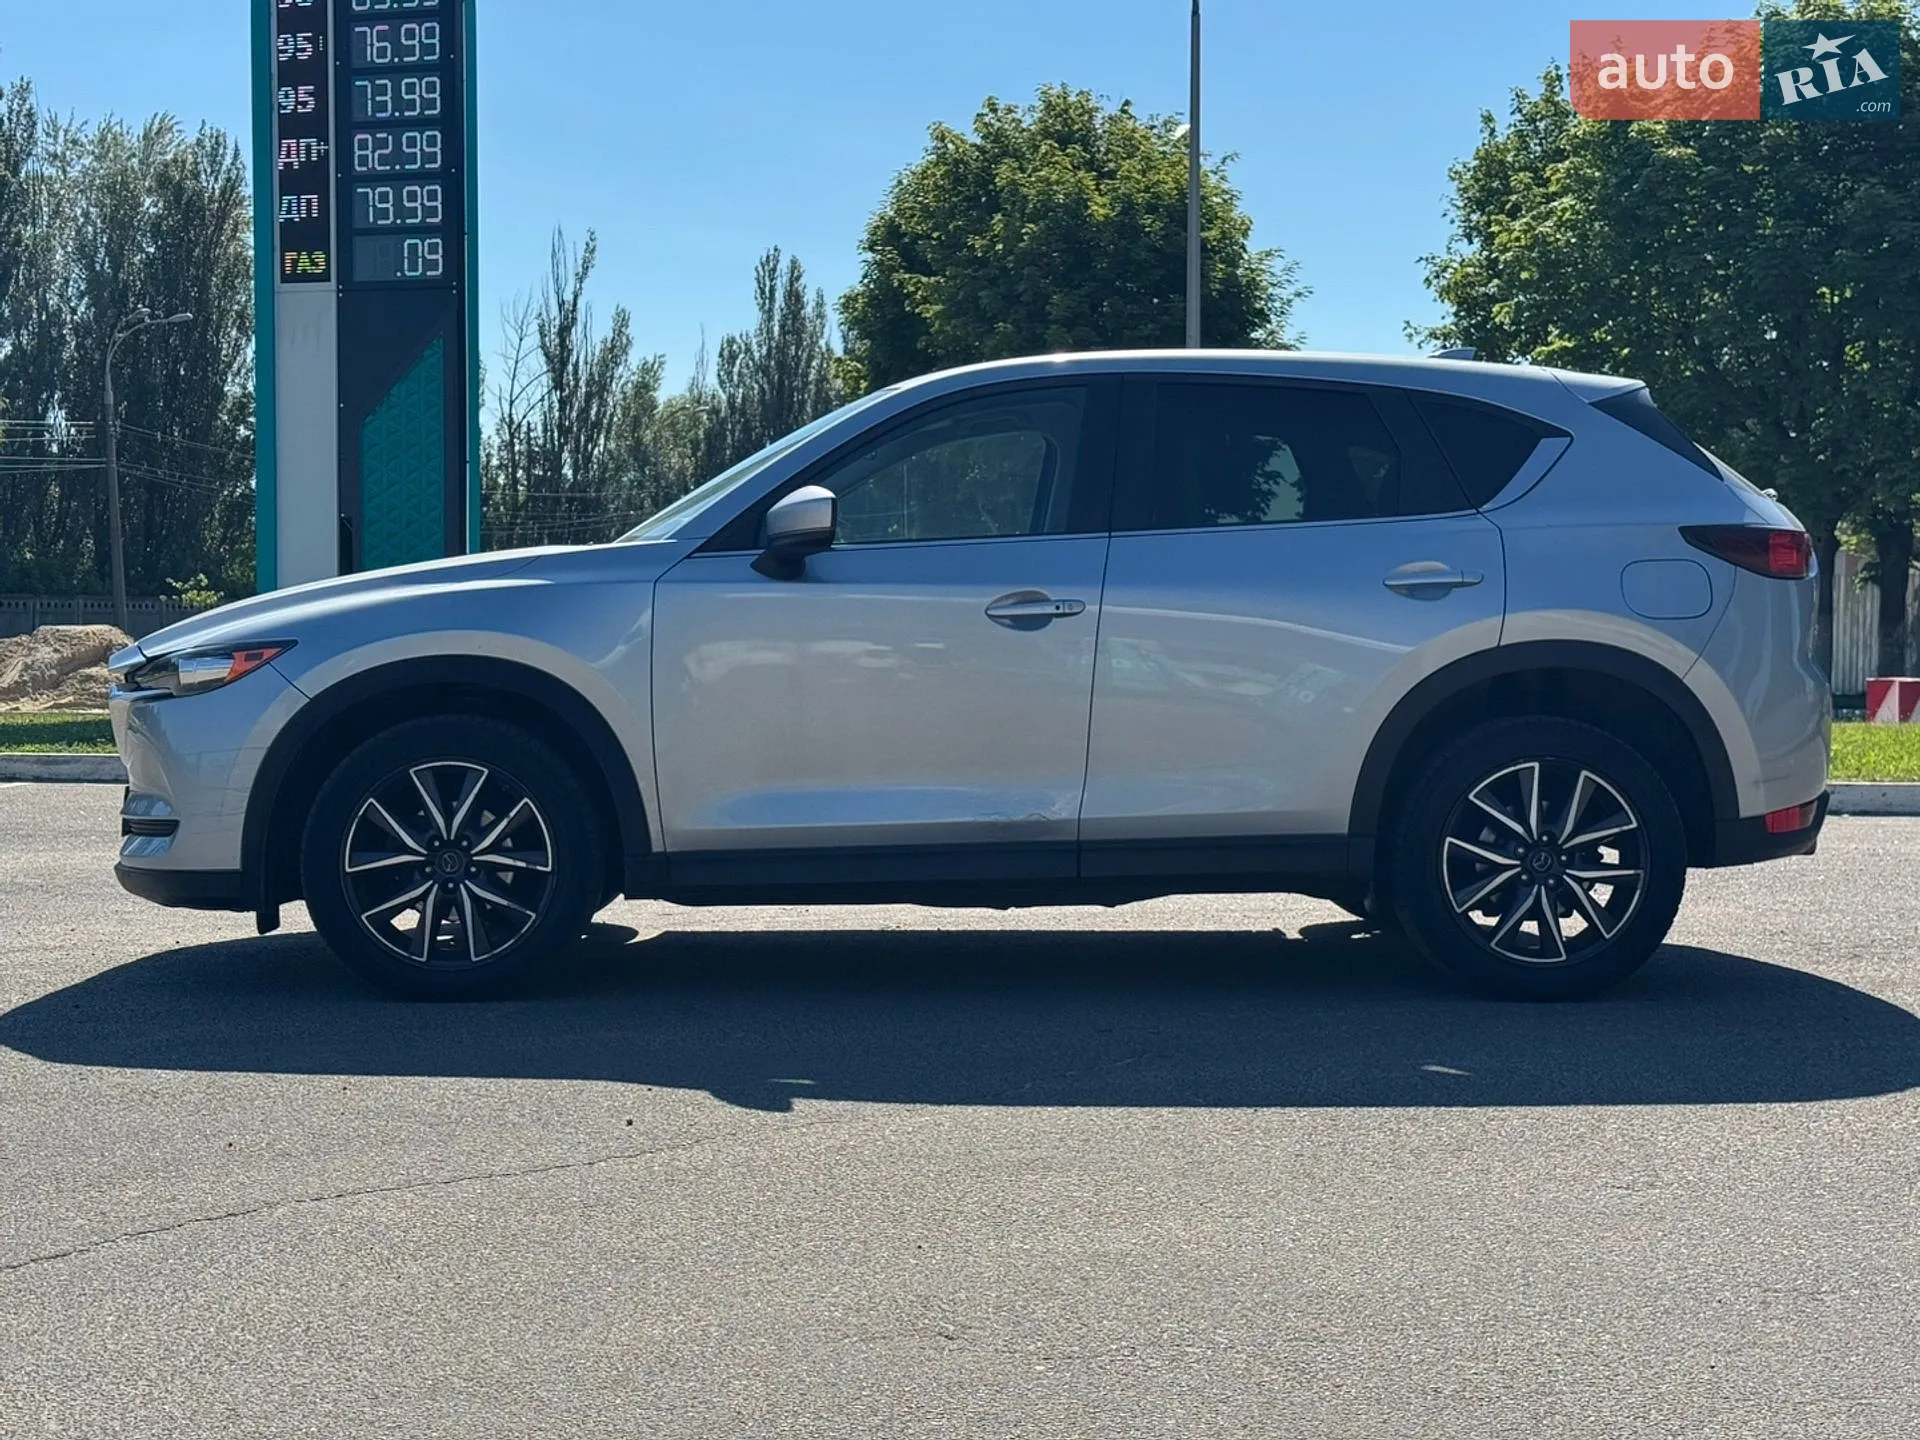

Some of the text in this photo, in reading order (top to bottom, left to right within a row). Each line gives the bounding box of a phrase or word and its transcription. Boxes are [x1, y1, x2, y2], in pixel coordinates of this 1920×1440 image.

[354, 22, 440, 64] 76.99
[277, 85, 316, 114] 95
[354, 76, 441, 117] 73.99
[277, 138, 329, 170] ДП+
[353, 129, 442, 171] 82.99
[278, 194, 319, 222] ДП
[356, 184, 443, 225] 79.99
[283, 250, 327, 274] ГАЗ
